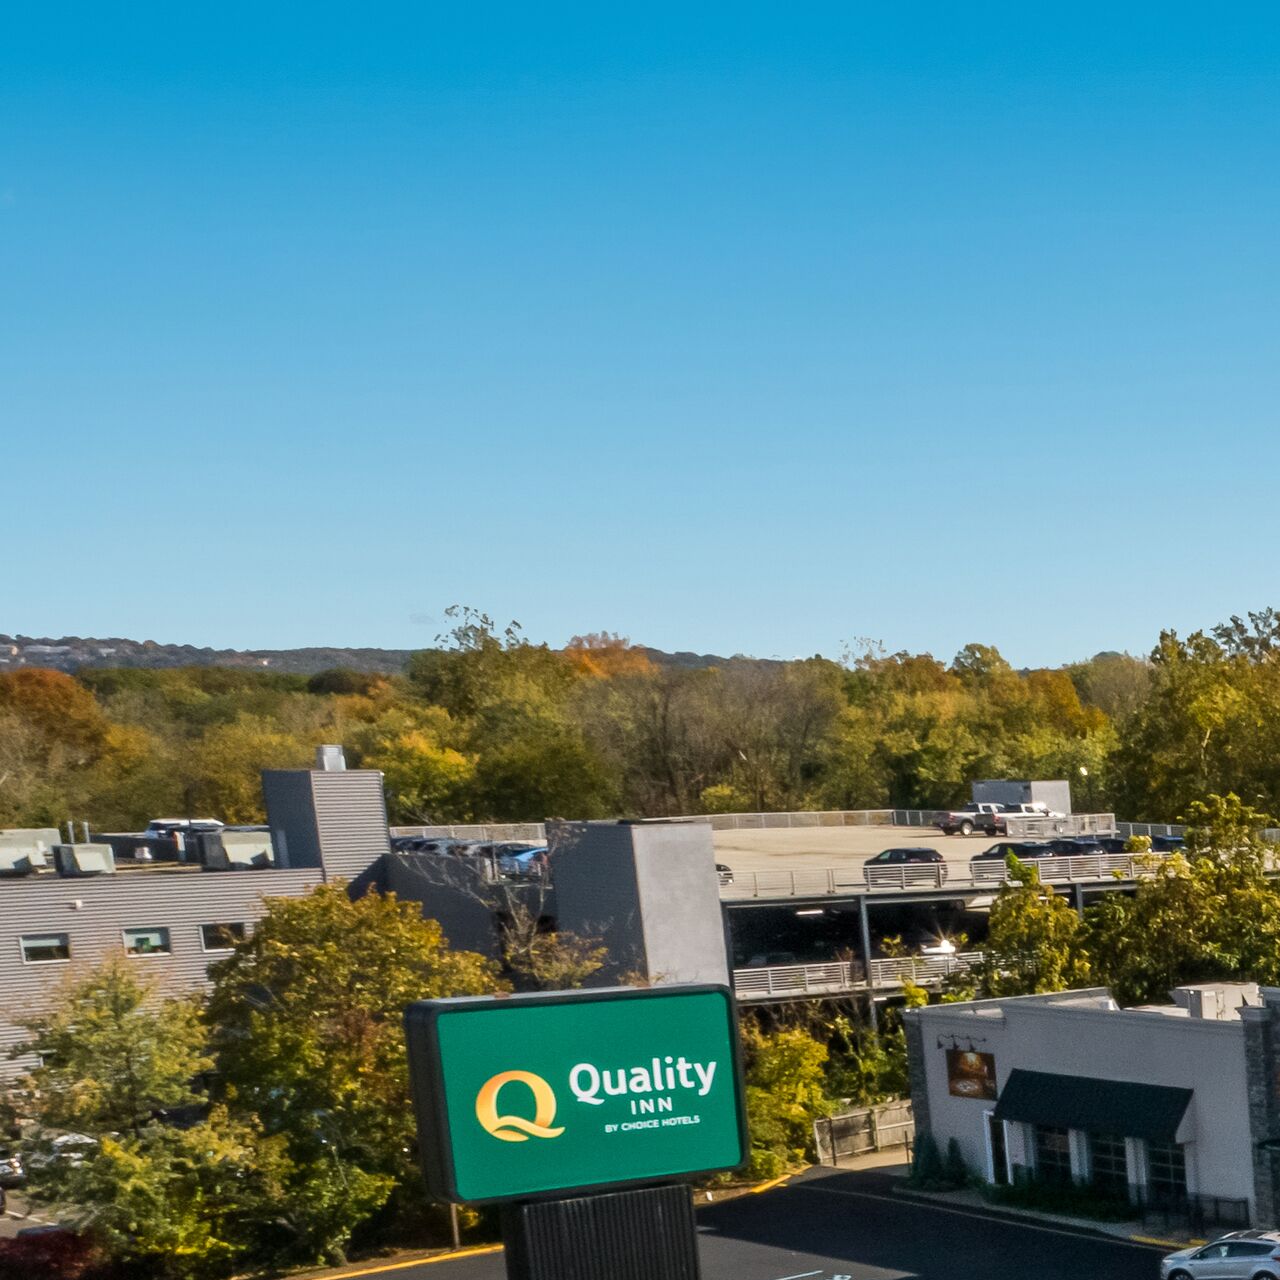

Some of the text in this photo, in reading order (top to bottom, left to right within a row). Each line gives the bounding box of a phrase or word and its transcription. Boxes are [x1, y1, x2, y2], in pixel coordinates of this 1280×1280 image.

[569, 1056, 717, 1105] Quality
[475, 1070, 566, 1142] Q
[631, 1097, 672, 1115] INN
[605, 1115, 700, 1134] BY CHOICE HOTELS
